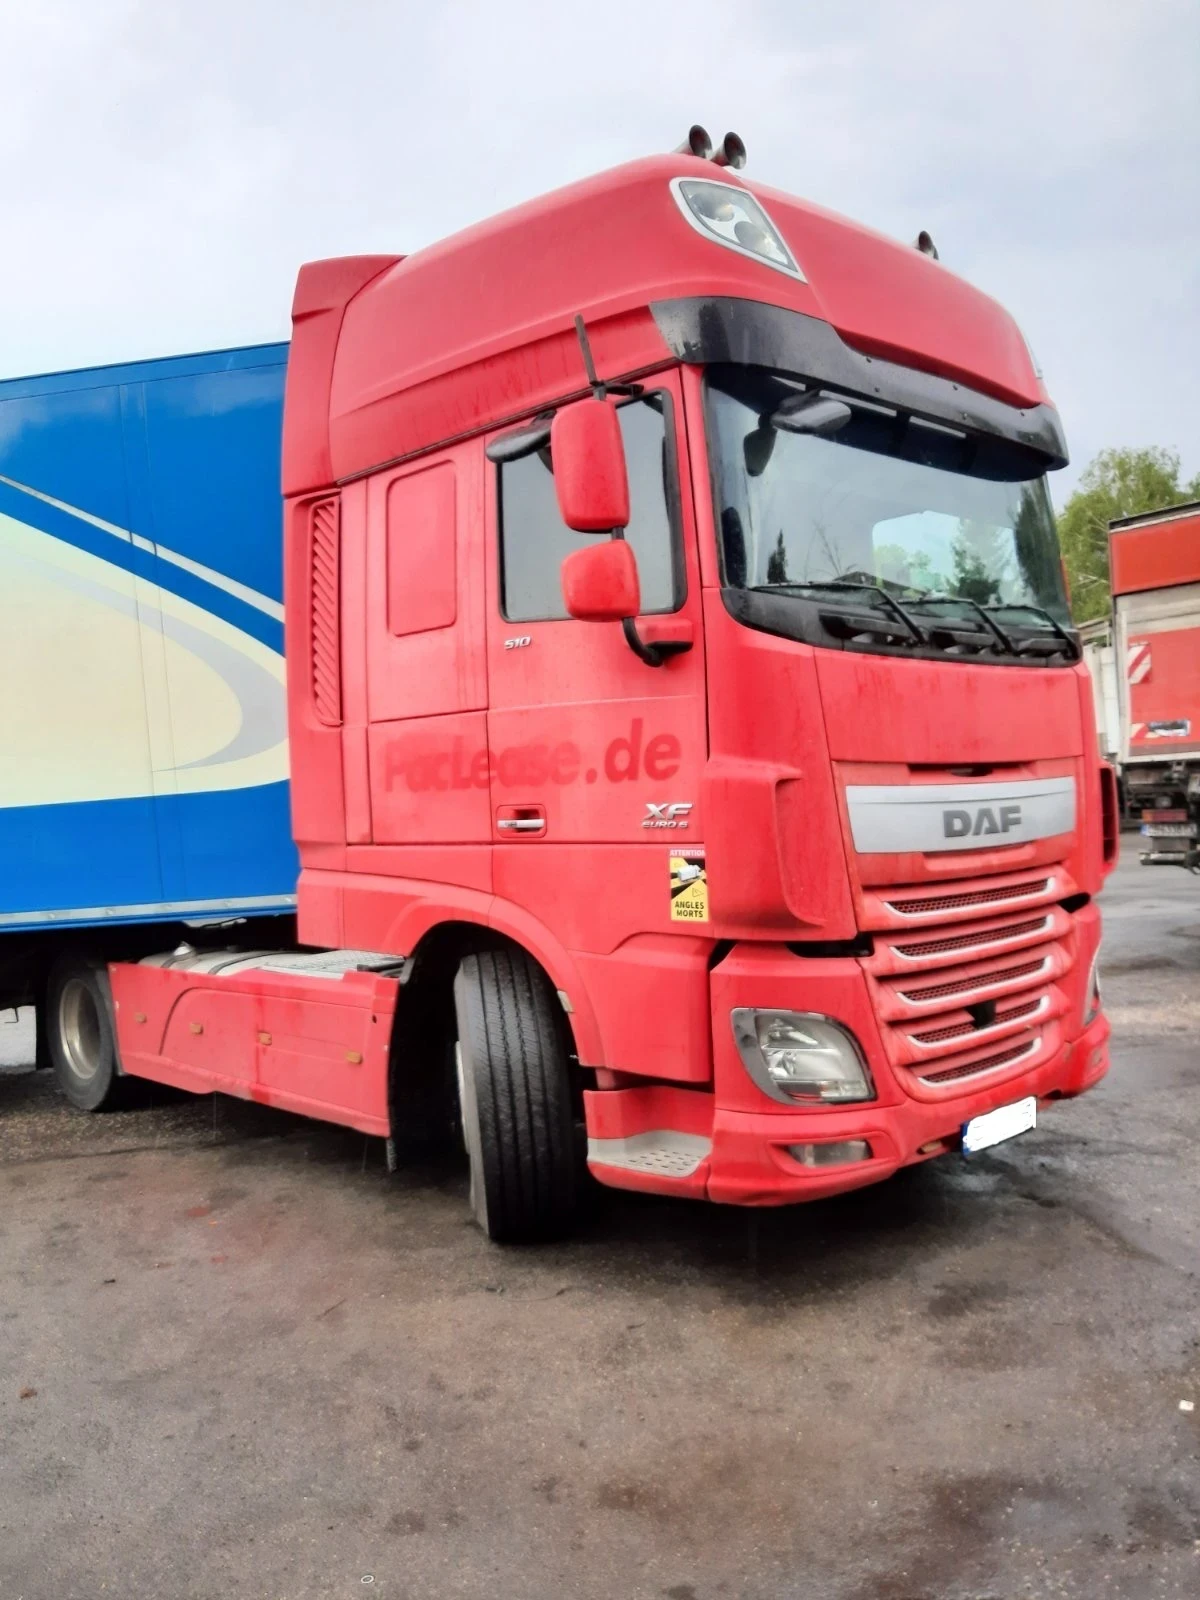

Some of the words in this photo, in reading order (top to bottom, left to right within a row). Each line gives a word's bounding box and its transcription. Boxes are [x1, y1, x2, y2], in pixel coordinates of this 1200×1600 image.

[504, 636, 532, 650] 510
[644, 803, 693, 821] XF
[642, 821, 676, 829] EURO
[678, 821, 689, 829] 6
[942, 805, 1022, 838] DAF
[674, 901, 705, 910] ANGLES
[676, 910, 704, 918] MORTS
